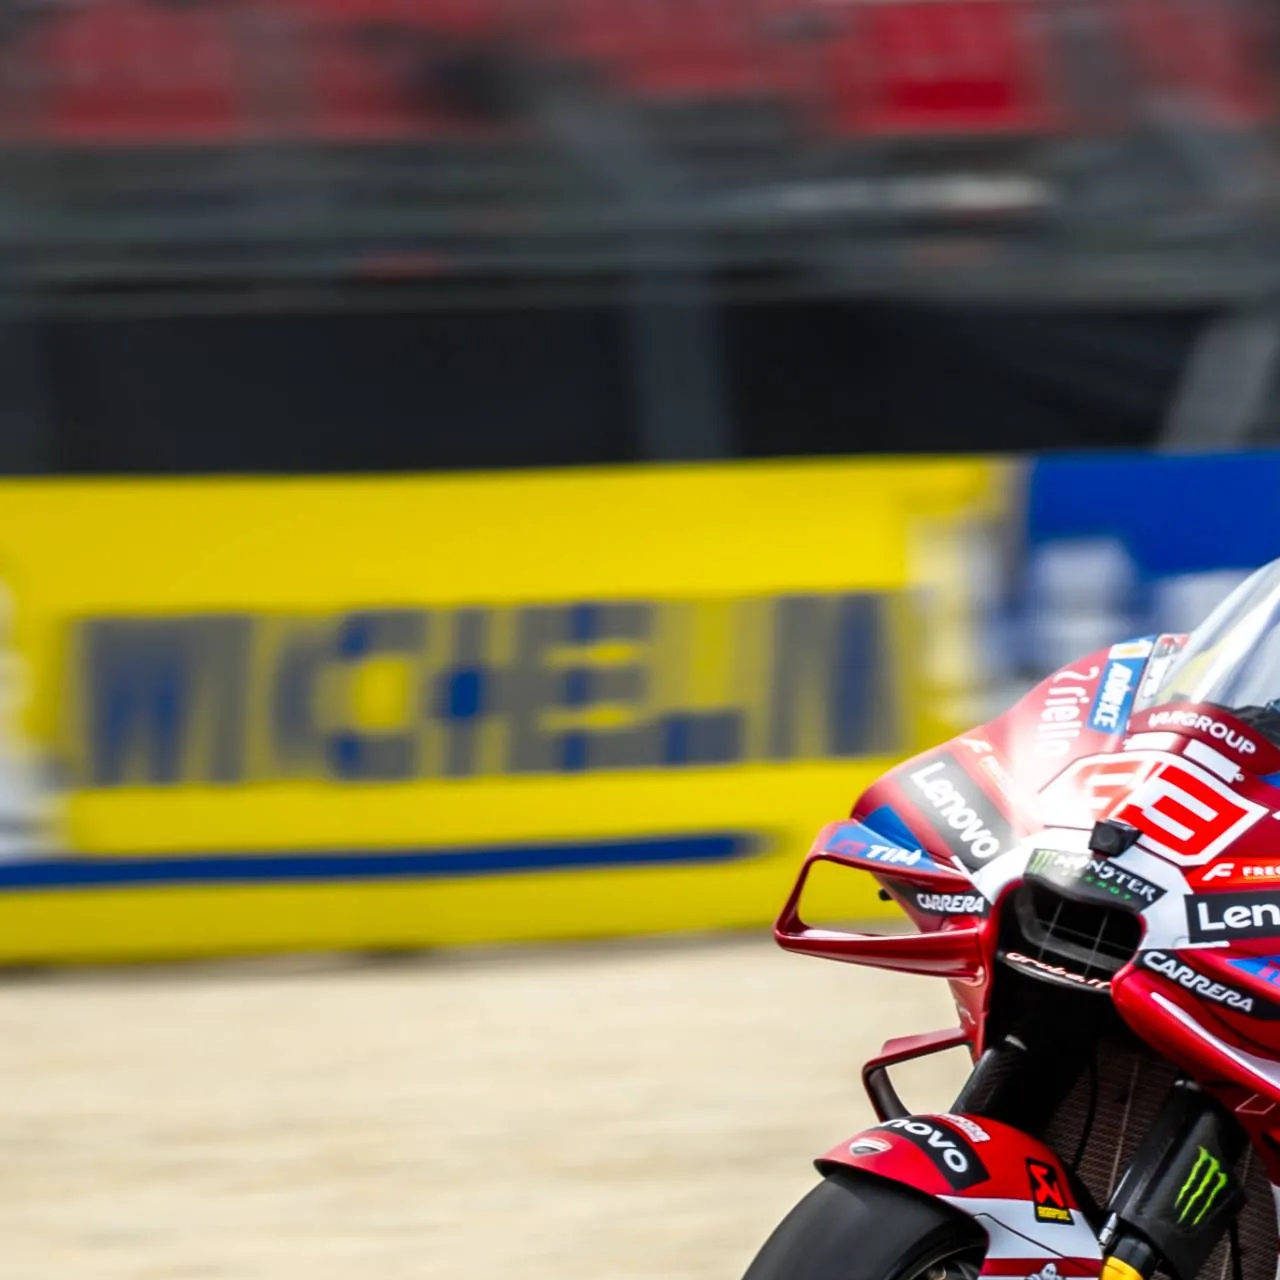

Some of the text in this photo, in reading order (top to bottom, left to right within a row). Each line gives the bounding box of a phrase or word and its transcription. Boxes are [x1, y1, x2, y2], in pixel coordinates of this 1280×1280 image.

[910, 761, 1000, 859] Lenovo
[866, 844, 922, 866] TIM
[916, 893, 986, 913] CARRERA
[1142, 951, 1254, 1012] CARRERA
